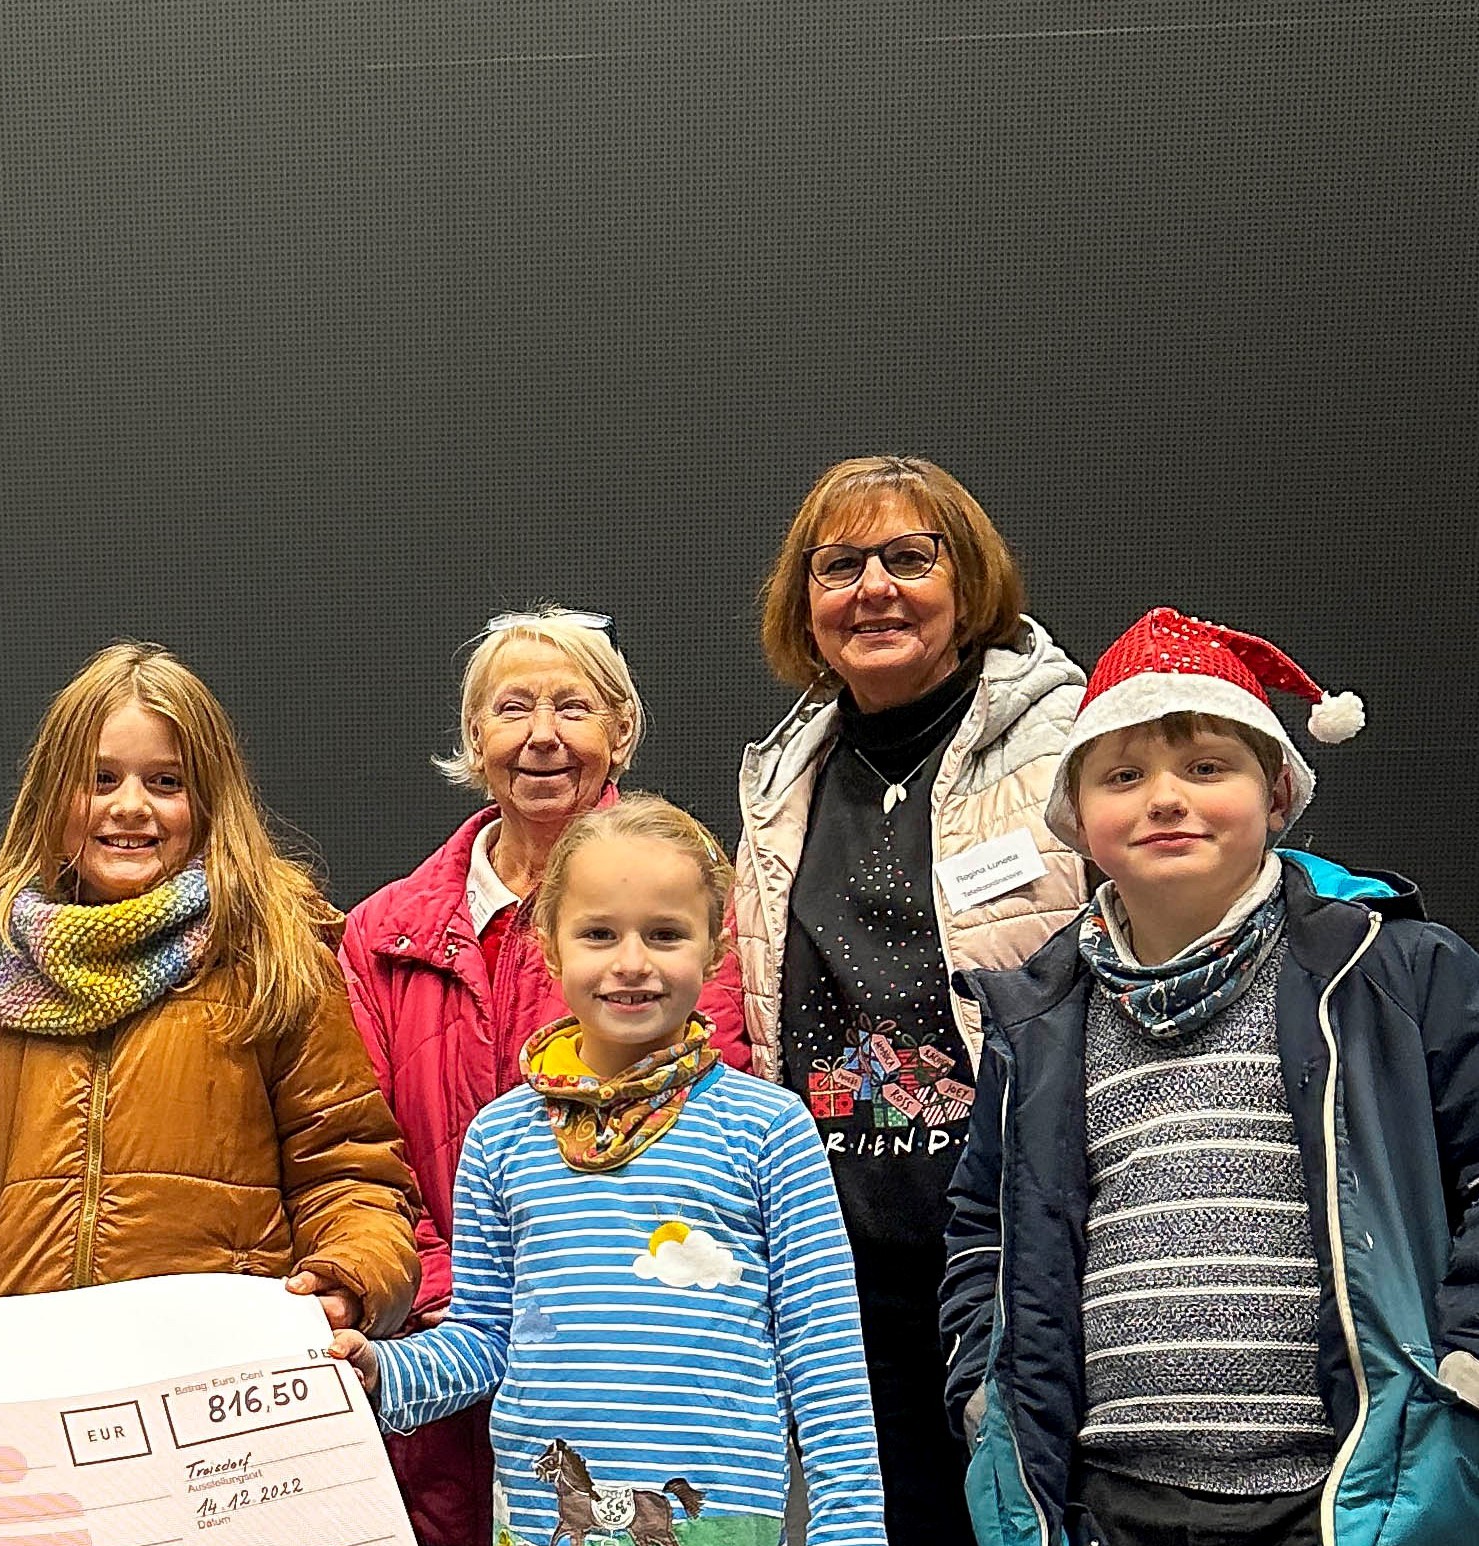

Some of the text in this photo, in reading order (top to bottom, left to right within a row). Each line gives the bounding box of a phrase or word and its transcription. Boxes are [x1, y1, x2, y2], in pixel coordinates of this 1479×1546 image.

[889, 1088, 914, 1111] ROSS
[944, 1084, 970, 1099] JOEY
[208, 1378, 308, 1423] 816,50
[87, 1425, 126, 1443] EUR
[186, 1452, 252, 1479] Troisdorf
[188, 1469, 263, 1494] Ausstellungsort
[197, 1478, 304, 1518] 14.12.2022
[197, 1516, 231, 1530] Datum
